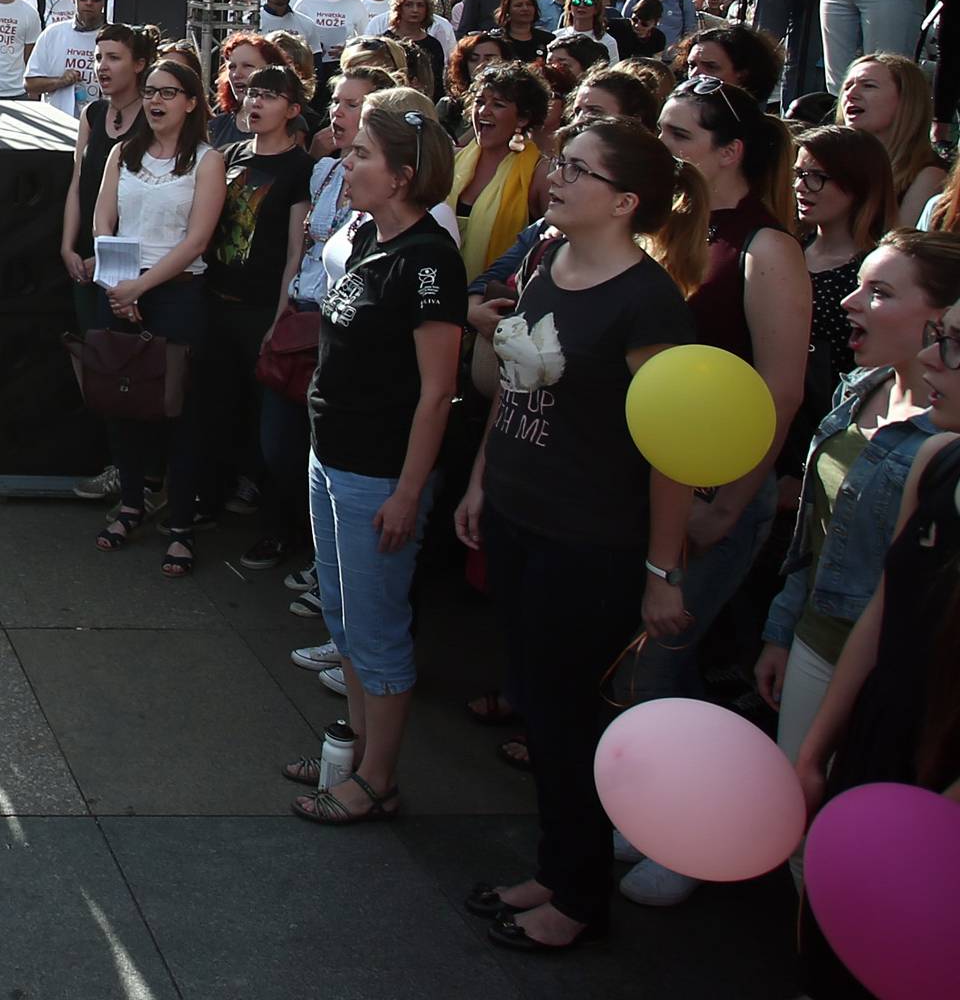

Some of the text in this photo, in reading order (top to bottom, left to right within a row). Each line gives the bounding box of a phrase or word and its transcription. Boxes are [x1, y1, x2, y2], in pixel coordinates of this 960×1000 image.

[65, 56, 94, 70] MOŽ
[67, 48, 94, 57] Hrvats
[527, 388, 555, 416] UP
[514, 413, 551, 448] ME
